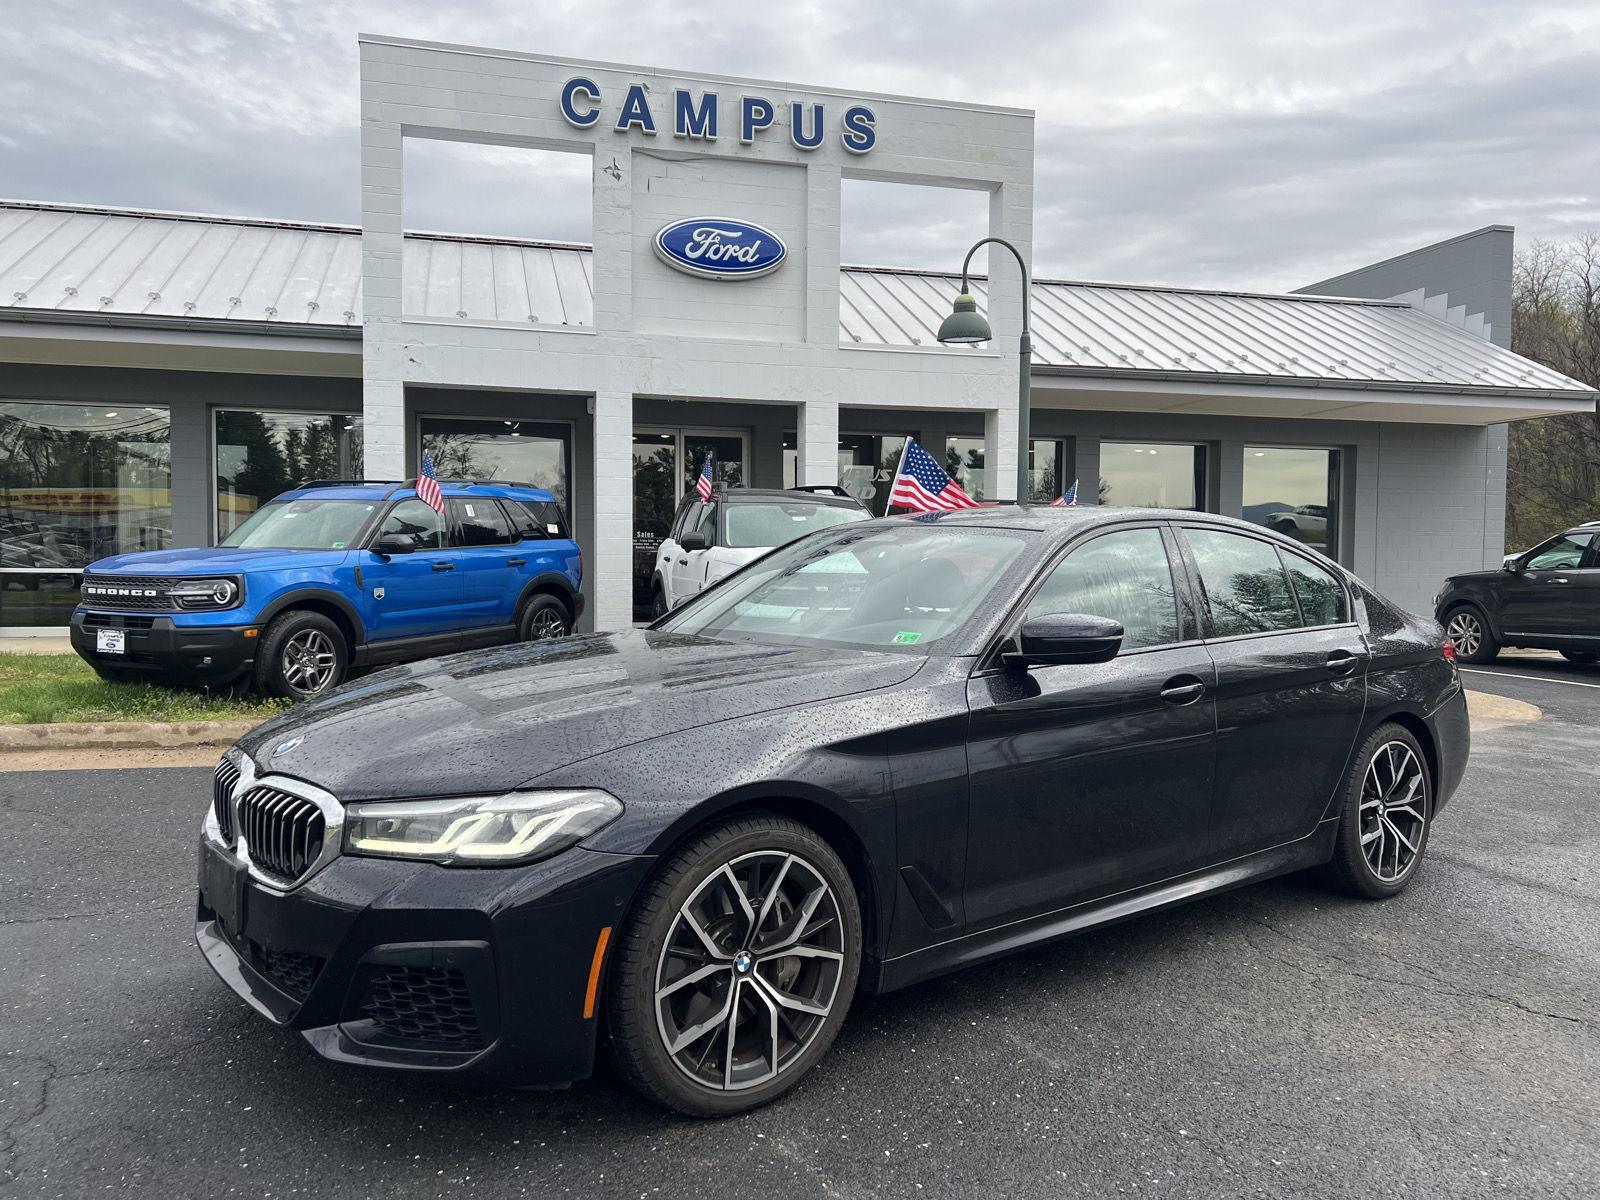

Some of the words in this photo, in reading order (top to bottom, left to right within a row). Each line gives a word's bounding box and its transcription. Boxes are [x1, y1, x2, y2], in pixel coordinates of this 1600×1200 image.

[560, 76, 877, 155] CAMPUS
[685, 227, 761, 263] Ford
[87, 587, 157, 596] BRONCO
